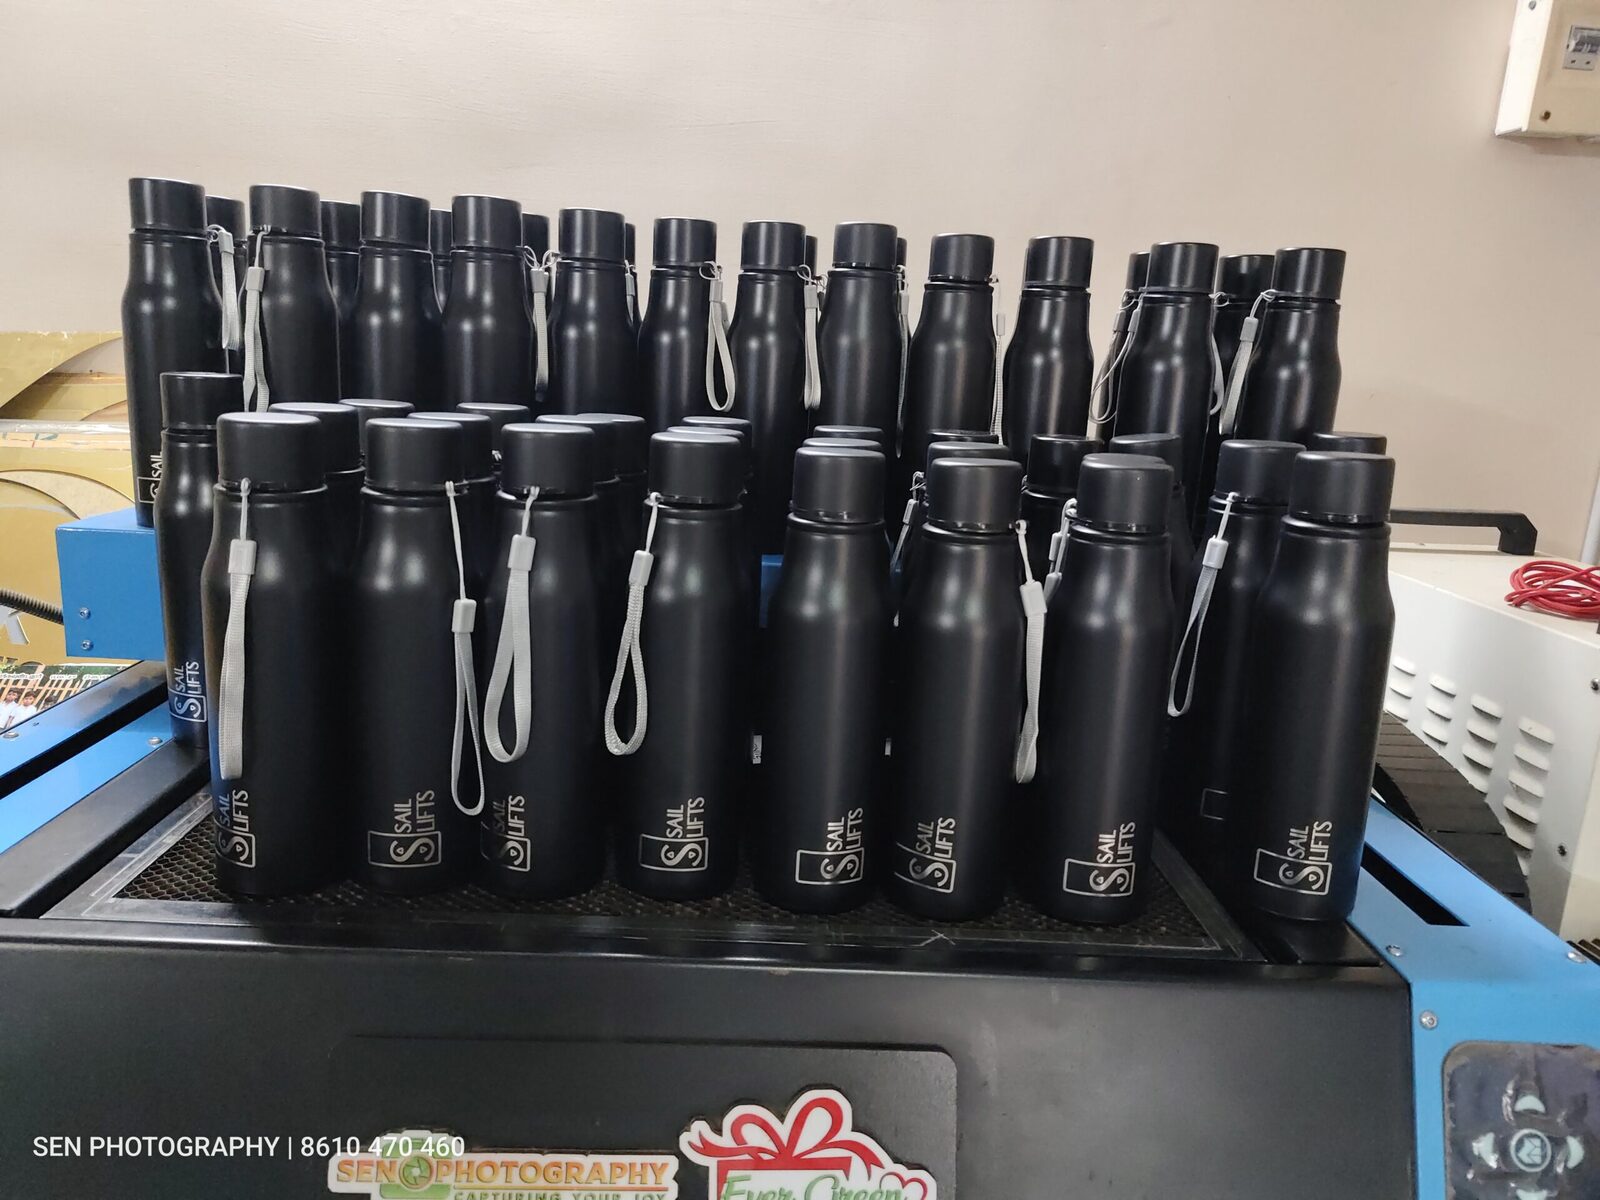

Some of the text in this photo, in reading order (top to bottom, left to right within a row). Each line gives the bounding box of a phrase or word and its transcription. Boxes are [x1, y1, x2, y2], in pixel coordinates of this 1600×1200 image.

[173, 665, 186, 693] SAIL
[185, 661, 202, 694] LIFTS
[218, 793, 231, 827] SAIL
[232, 790, 249, 832] LIFTS
[393, 798, 412, 833] SAIL
[416, 790, 435, 832] LIFTS
[508, 795, 525, 837] LIFTS
[665, 804, 684, 838] SAIL
[686, 797, 705, 838] LIFTS
[826, 816, 845, 851] SAIL
[845, 807, 864, 850] LIFTS
[915, 821, 934, 854] SAIL
[934, 817, 956, 858] LIFTS
[1096, 829, 1117, 863] SAIL
[1116, 821, 1136, 863] LIFTS
[1286, 825, 1309, 859] SAIL
[1308, 820, 1333, 861] LIFTS
[336, 1158, 669, 1185] SEN PHOTOGRAPHY
